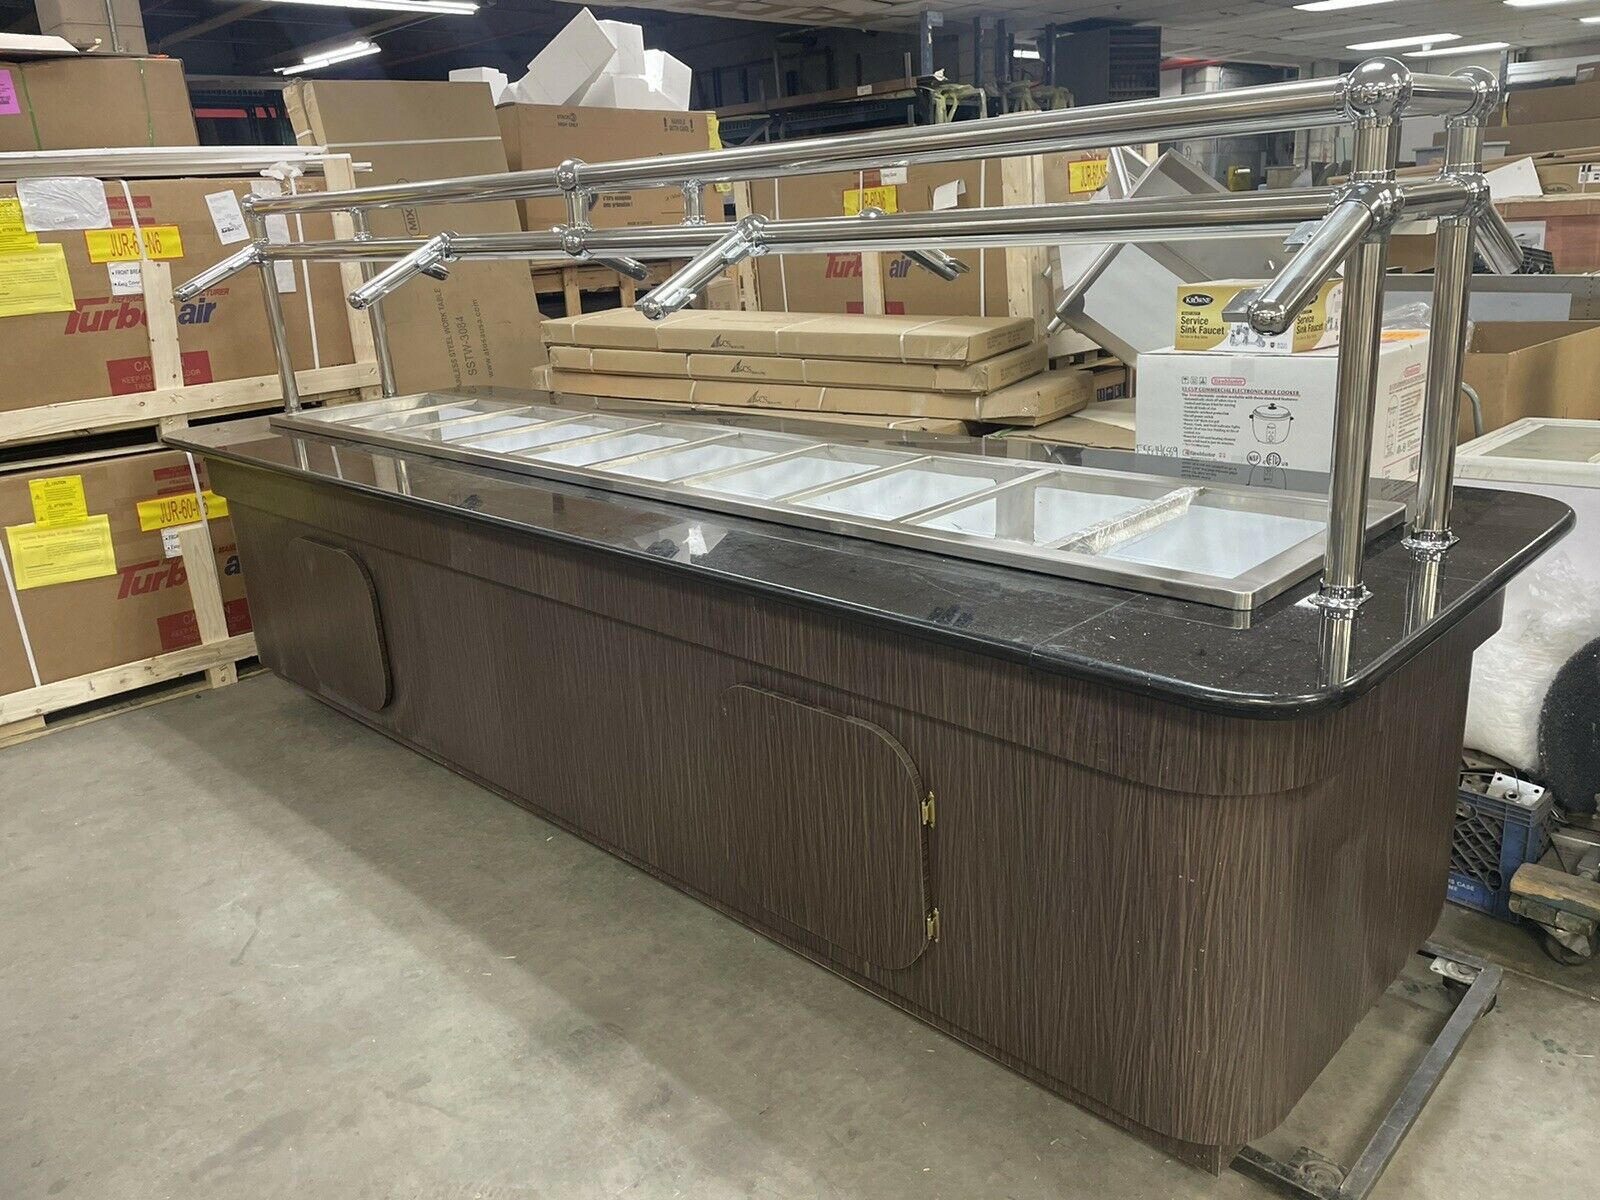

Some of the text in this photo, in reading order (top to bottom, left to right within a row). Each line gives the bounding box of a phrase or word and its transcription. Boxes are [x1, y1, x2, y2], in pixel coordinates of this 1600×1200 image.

[407, 208, 419, 232] MIX
[110, 231, 162, 257] JUR-6-N6
[825, 252, 863, 279] Turb
[64, 296, 217, 336] Turb air
[1180, 316, 1209, 326] Service
[1180, 326, 1225, 335] Sink Faucet
[455, 315, 478, 377] SSTW-3084
[117, 560, 188, 600] Turb
